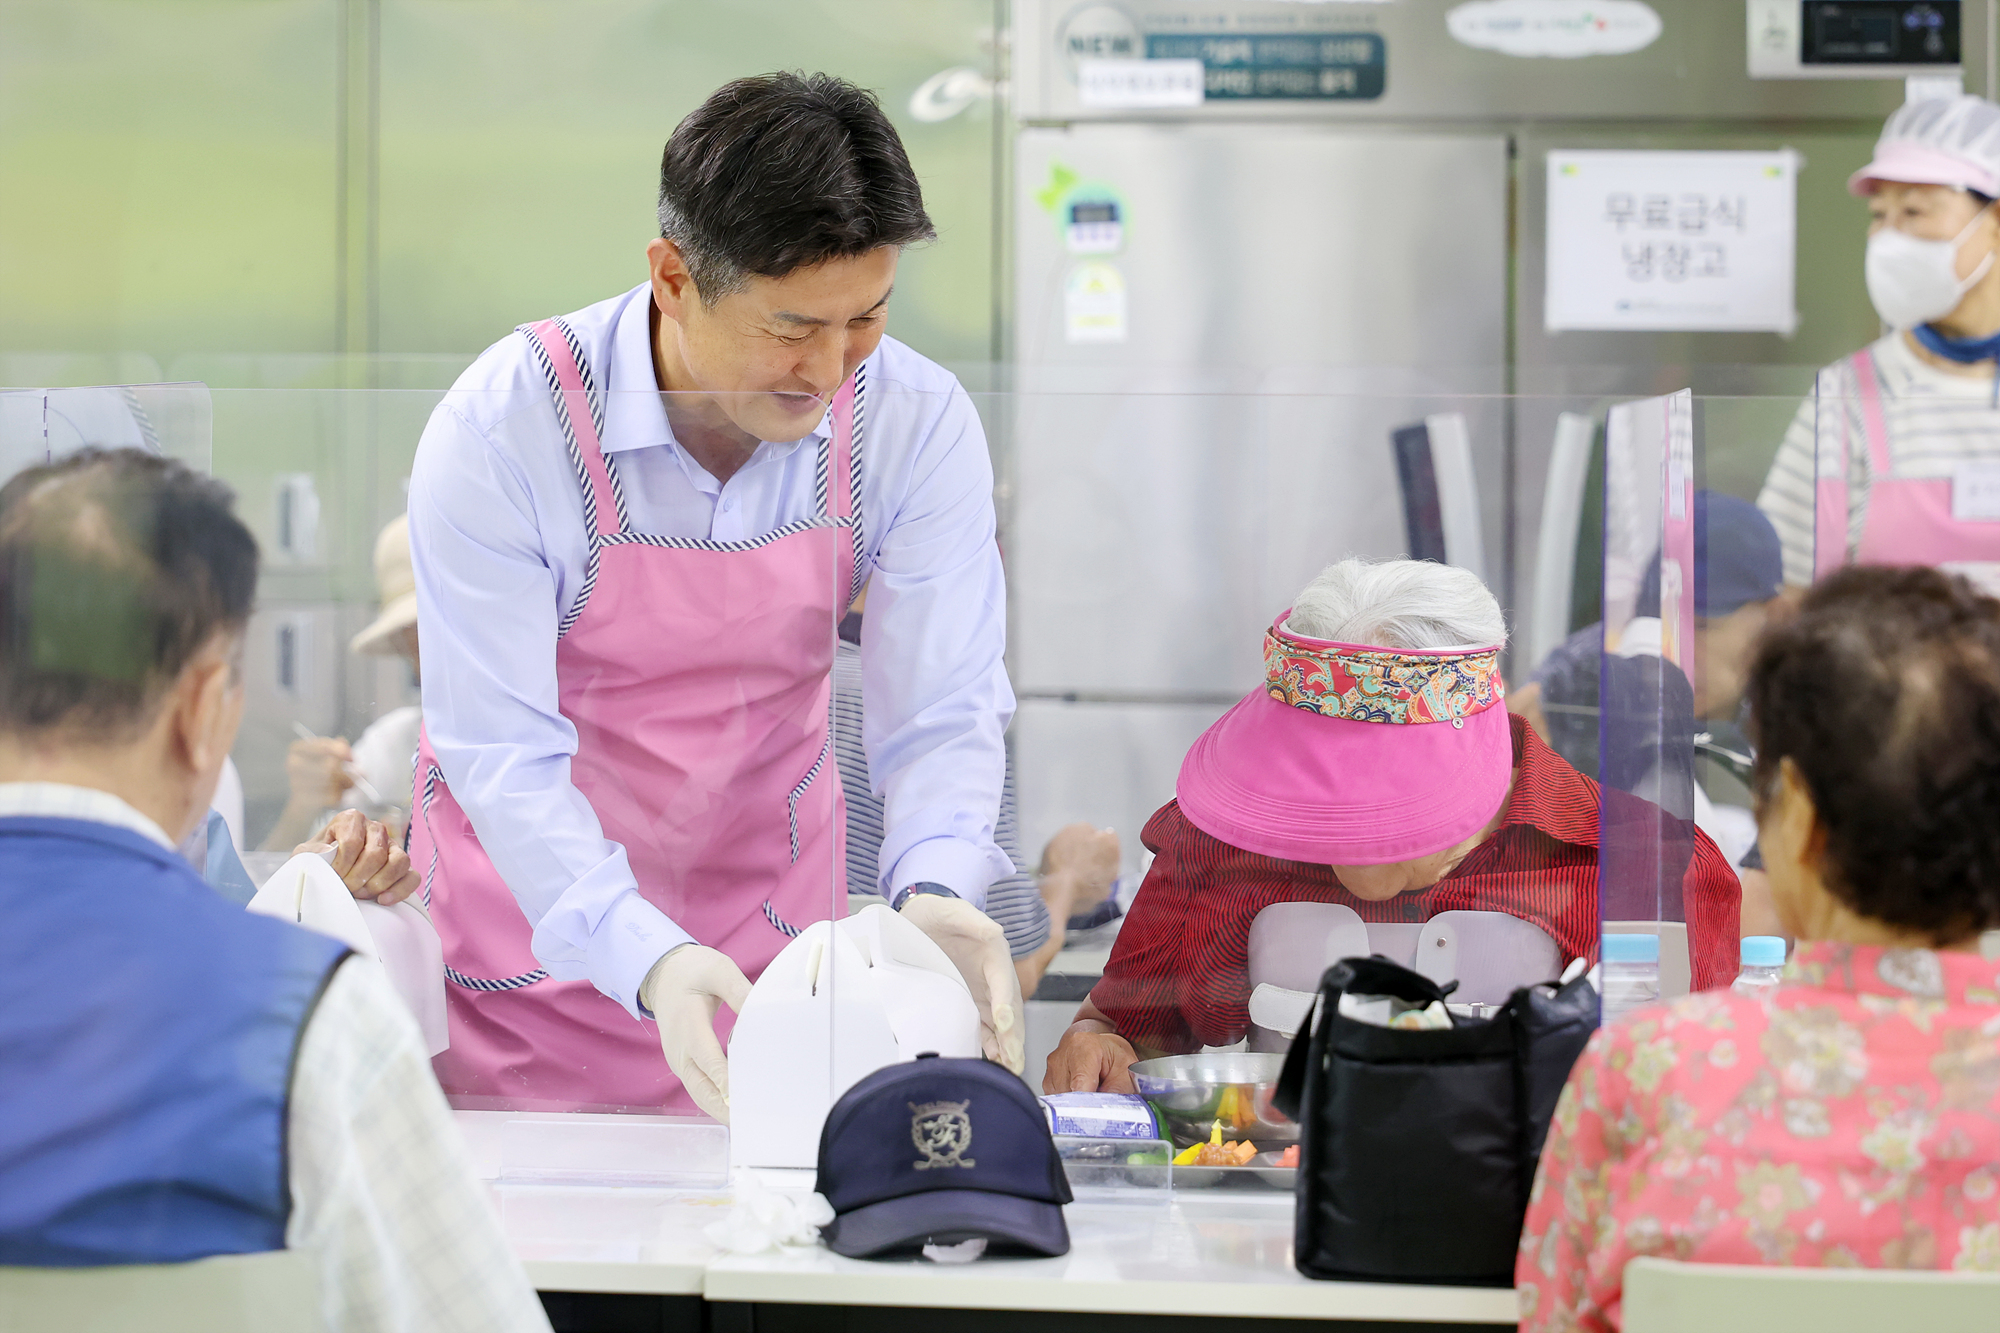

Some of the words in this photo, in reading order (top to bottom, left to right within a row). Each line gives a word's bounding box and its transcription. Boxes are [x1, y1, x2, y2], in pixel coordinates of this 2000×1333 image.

[1066, 34, 1133, 56] NEW
[1603, 191, 1747, 234] 무료급식
[1620, 241, 1729, 283] 냉장고
